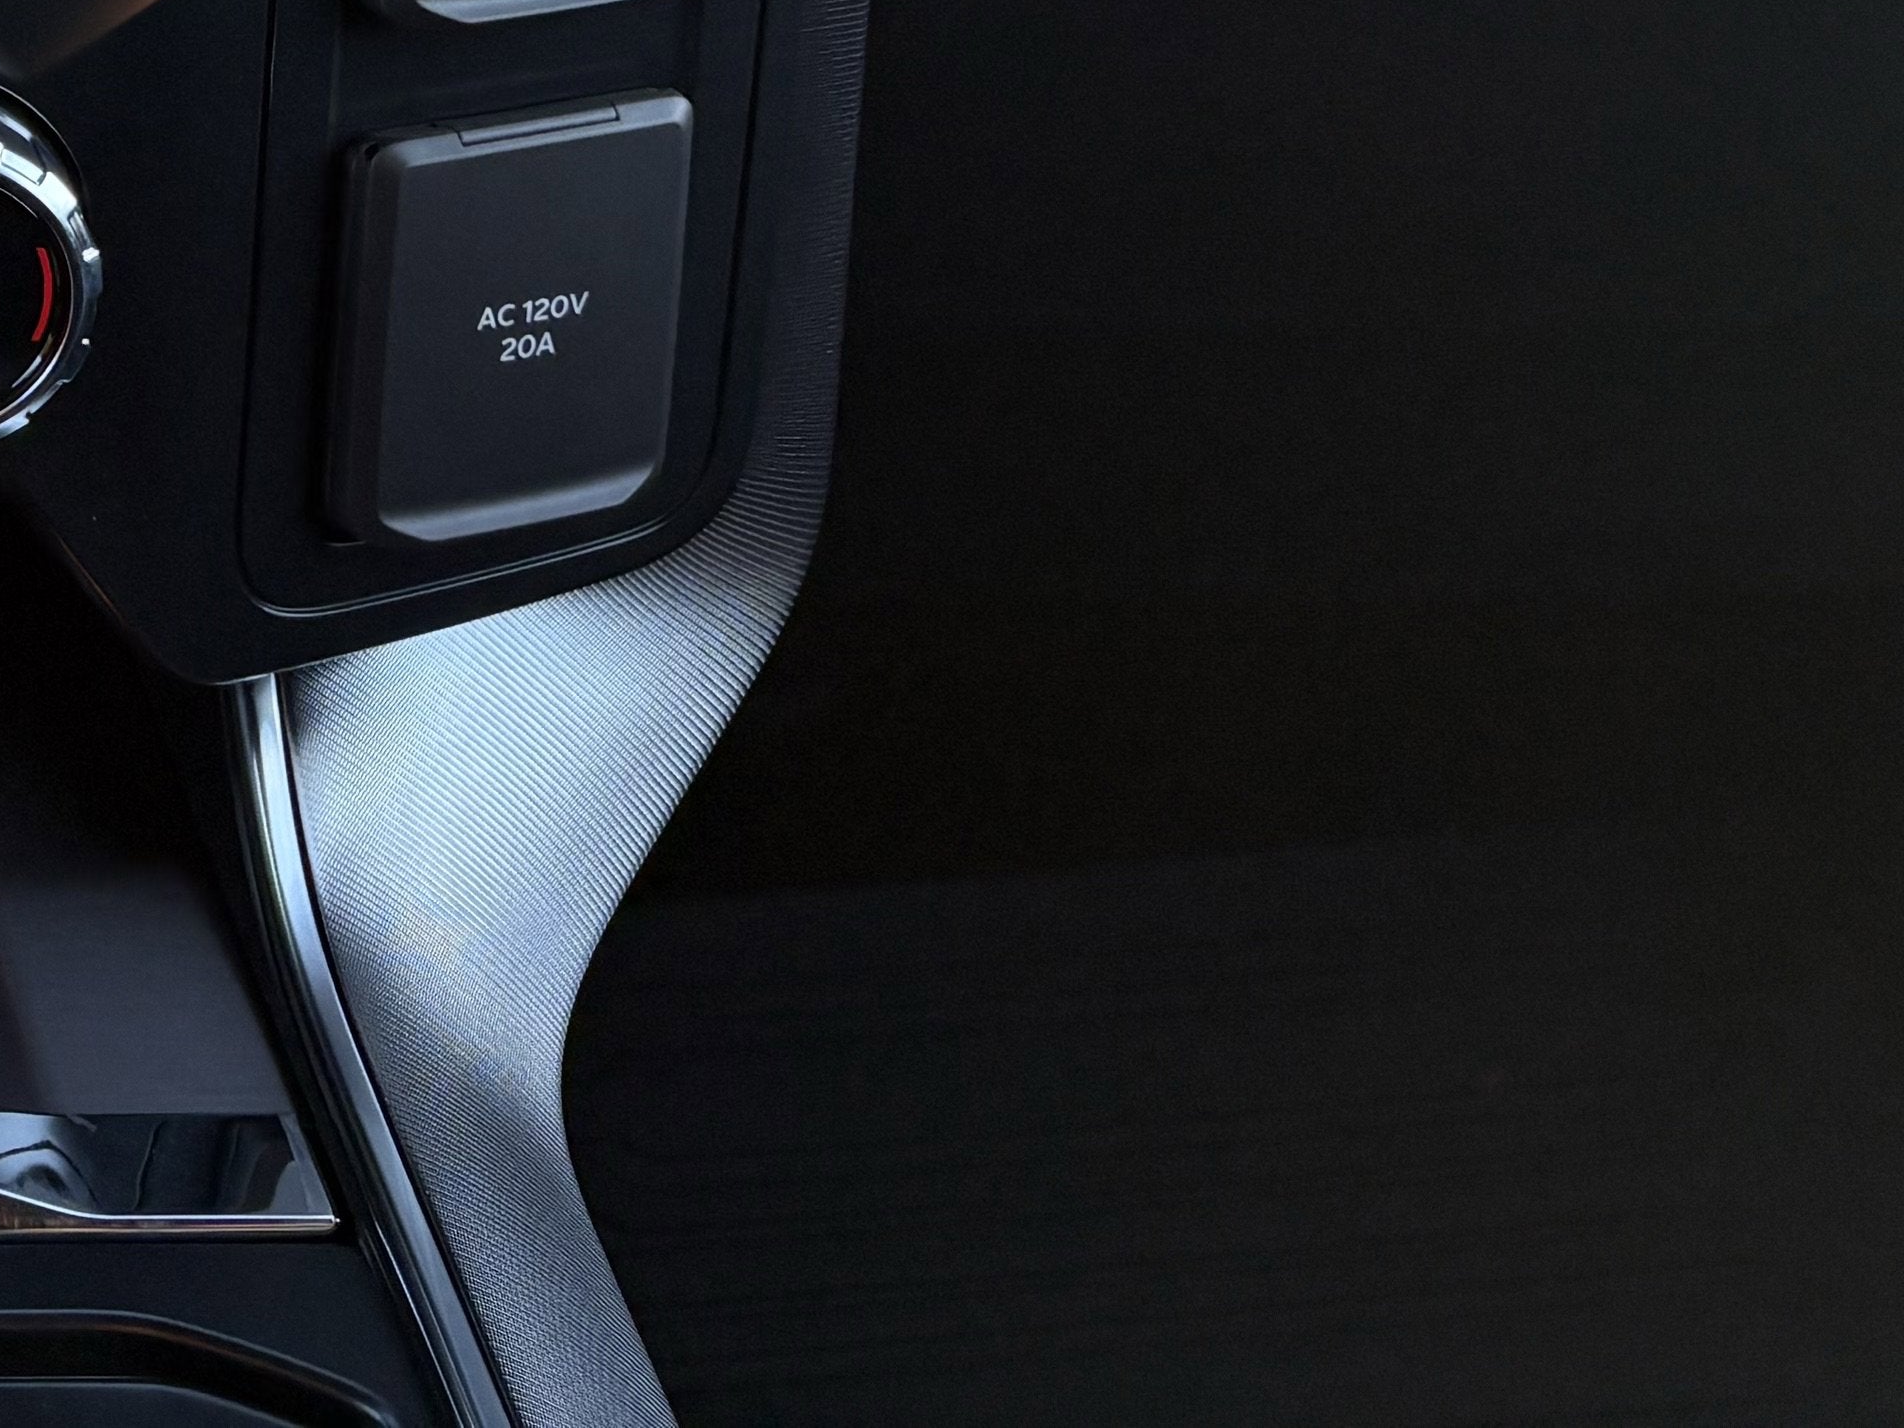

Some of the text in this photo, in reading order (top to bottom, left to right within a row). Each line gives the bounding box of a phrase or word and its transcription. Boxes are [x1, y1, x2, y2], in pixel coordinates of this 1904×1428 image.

[478, 290, 589, 330] AC 120V
[500, 333, 555, 362] 20A
